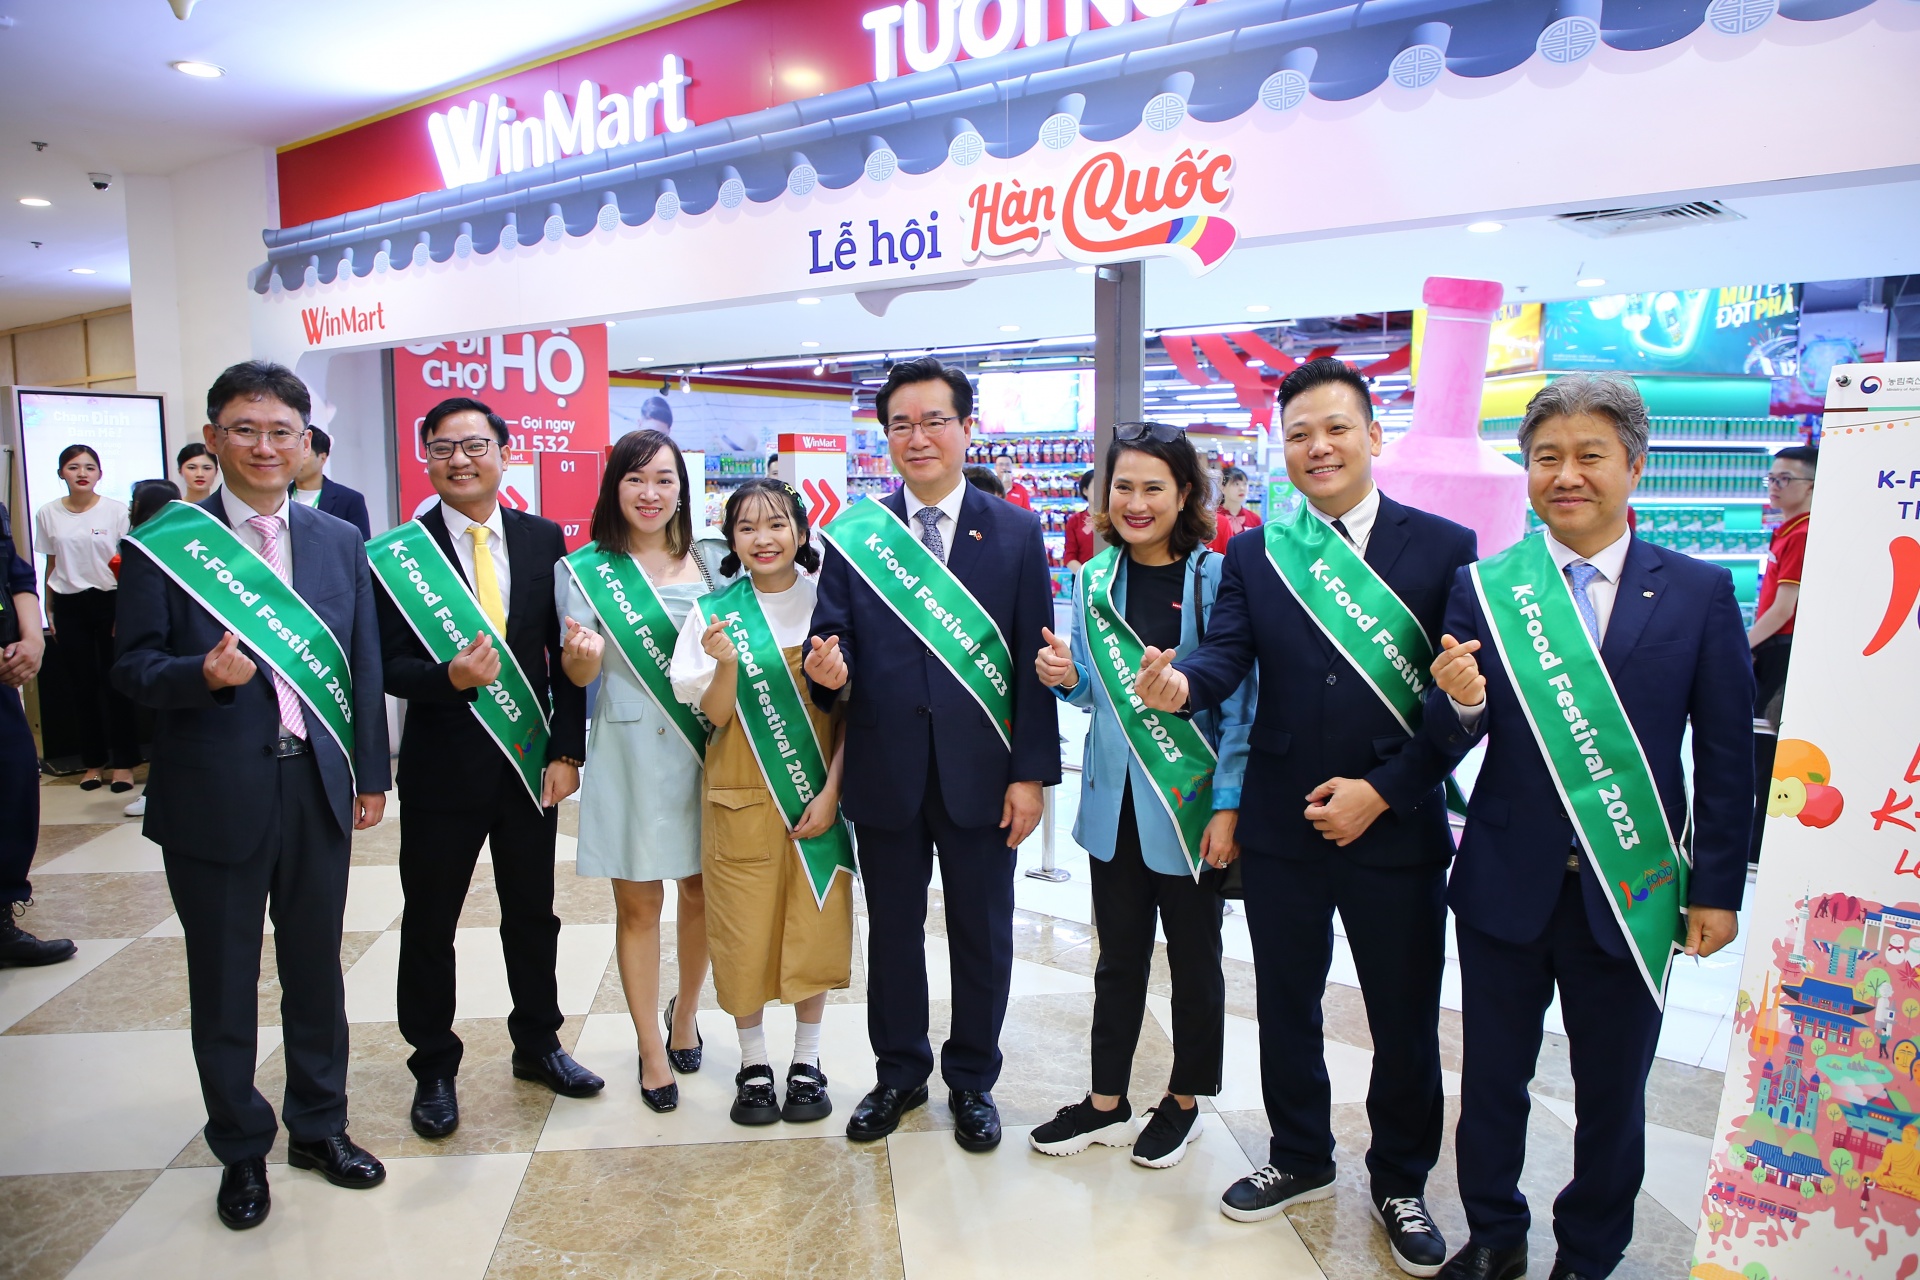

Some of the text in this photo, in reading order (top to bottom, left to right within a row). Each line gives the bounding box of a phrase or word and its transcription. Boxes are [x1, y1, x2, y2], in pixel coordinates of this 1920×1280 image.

[428, 53, 692, 190] WinMart
[809, 148, 1233, 274] Lễ hội Hàn Quốc
[302, 302, 386, 345] WinMart
[422, 327, 585, 408] CHỢ HỘ
[521, 415, 576, 434] Gọi ngay
[532, 435, 569, 452] 532
[802, 436, 837, 449] WinMart
[560, 460, 575, 473] 01
[564, 524, 580, 537] 07
[183, 539, 352, 724] K-Food Festival 2023
[388, 539, 442, 608] K-Food
[485, 679, 522, 723] 2023
[595, 562, 643, 626] K-Food
[864, 532, 1008, 697] K-Food Festival 2023
[1308, 557, 1379, 633] K-Food
[1087, 568, 1111, 633] K-Food
[1142, 713, 1184, 763] 2023
[724, 611, 815, 804] K-Food Festival 2023
[1511, 583, 1641, 851] K-Food Festival 2023
